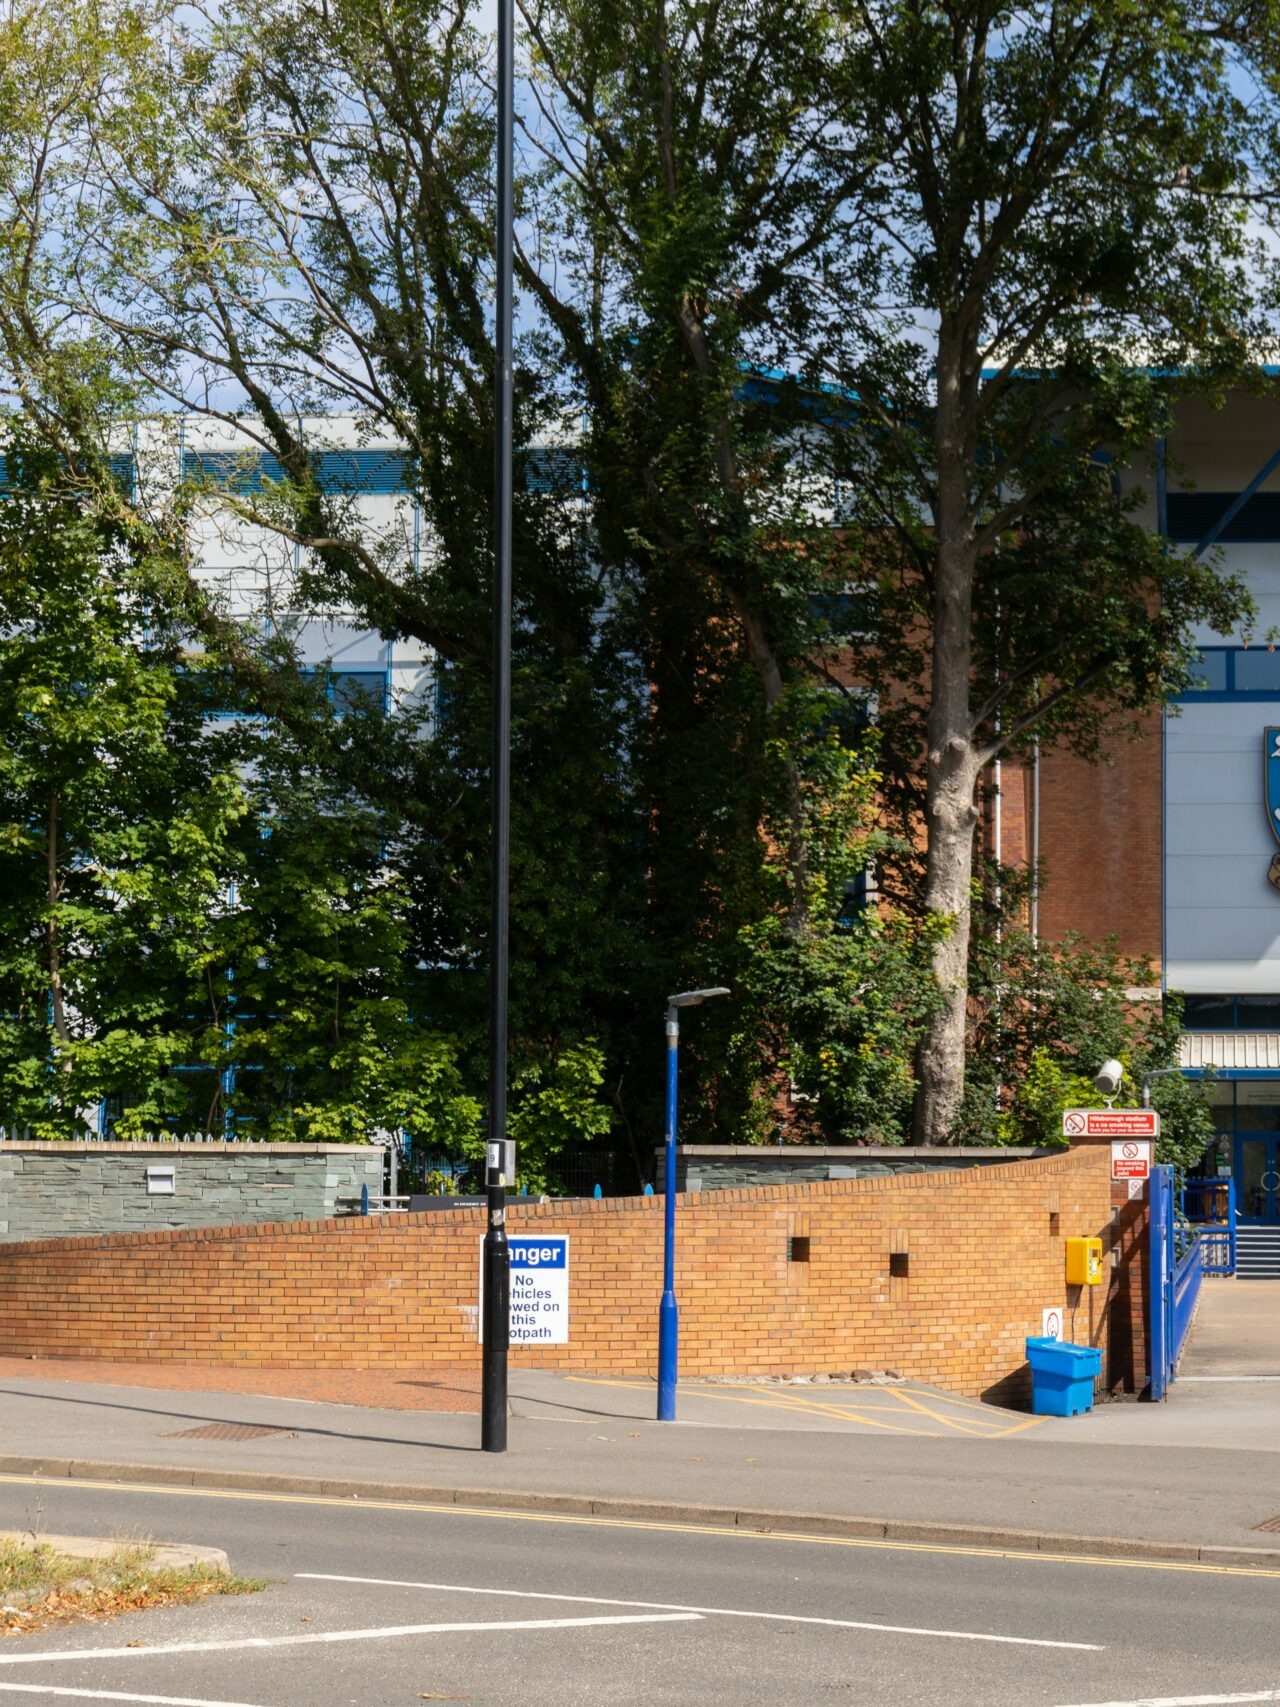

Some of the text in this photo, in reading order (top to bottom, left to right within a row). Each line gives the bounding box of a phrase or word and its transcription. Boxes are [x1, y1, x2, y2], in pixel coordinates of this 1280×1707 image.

[515, 1275, 534, 1286] No
[509, 1287, 552, 1299] hicles
[543, 1303, 560, 1312] on
[511, 1313, 536, 1325] this
[509, 1327, 552, 1341] otpath
